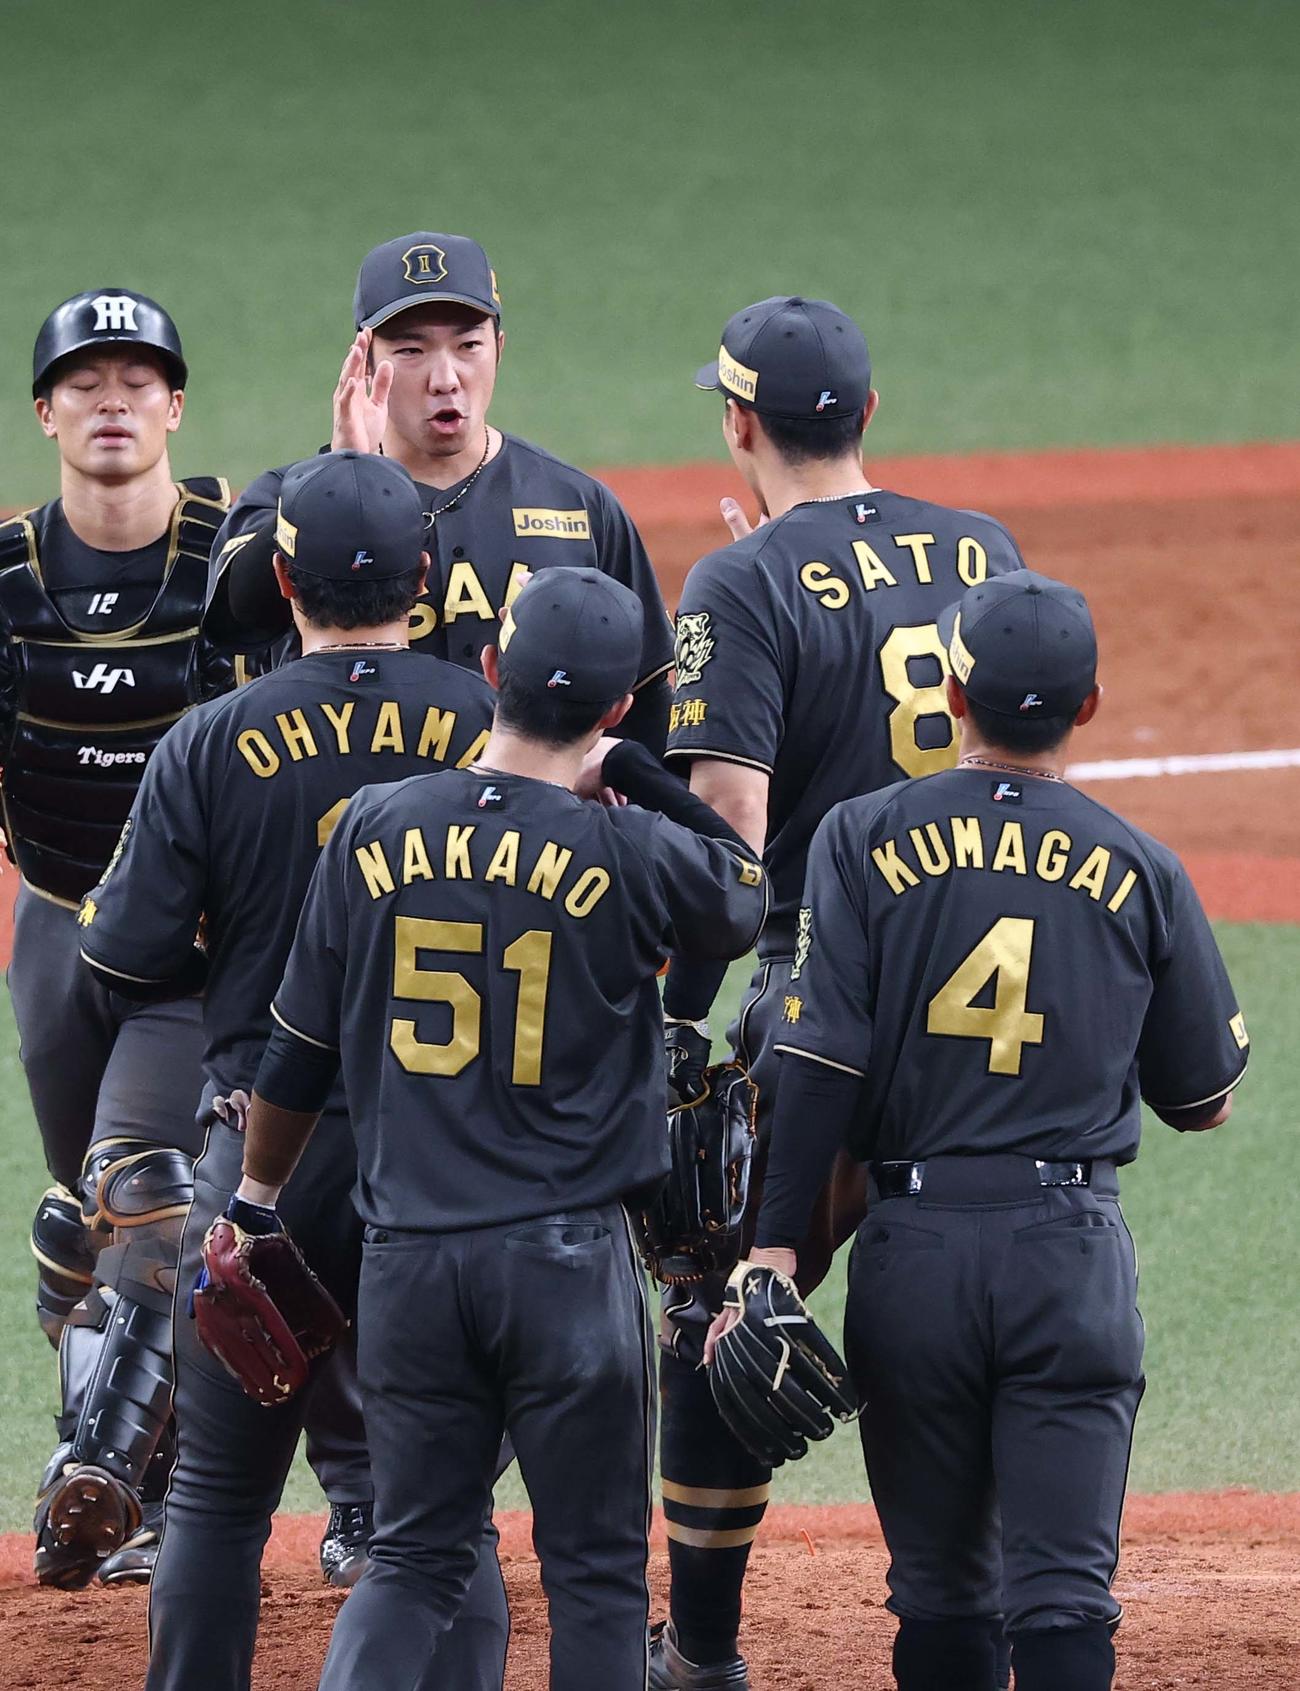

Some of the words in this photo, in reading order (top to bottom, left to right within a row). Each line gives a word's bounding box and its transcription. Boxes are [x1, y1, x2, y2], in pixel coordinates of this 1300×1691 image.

[517, 514, 587, 532] Joshin
[86, 592, 120, 616] 12
[800, 532, 988, 610] SATO
[878, 622, 964, 780] 8
[77, 745, 147, 768] Tigers
[354, 824, 612, 919] NAKANO
[871, 816, 1139, 914] KUMAGAI
[389, 914, 554, 1086] 51
[926, 916, 1045, 1076] 4
